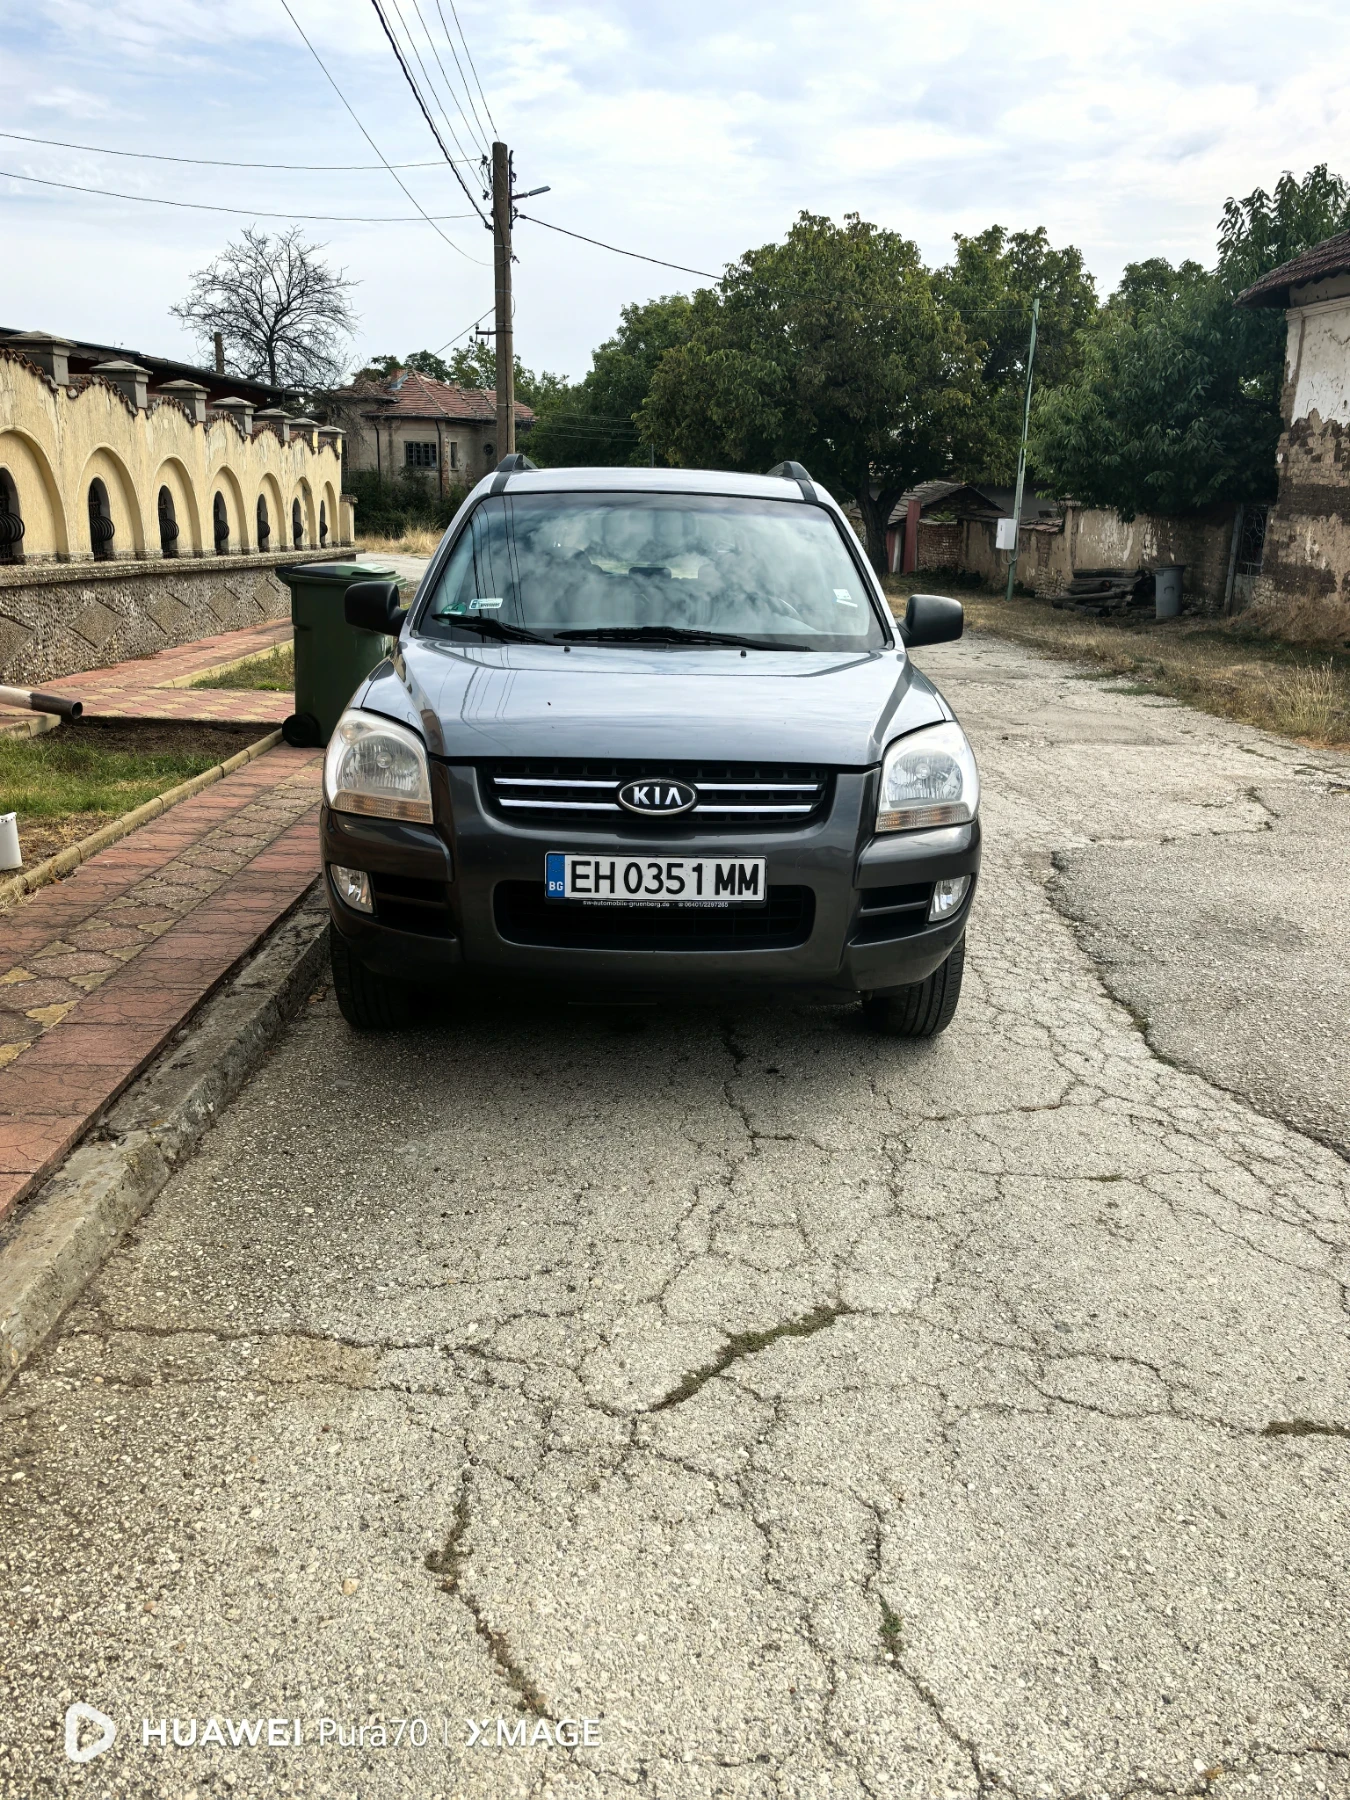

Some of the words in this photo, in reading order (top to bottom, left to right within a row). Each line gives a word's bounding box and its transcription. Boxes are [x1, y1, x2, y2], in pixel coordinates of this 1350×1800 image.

[633, 786, 683, 806] KIA
[548, 881, 564, 891] BG
[571, 861, 616, 894] EH
[623, 862, 704, 895] 0351
[714, 863, 759, 896] MM
